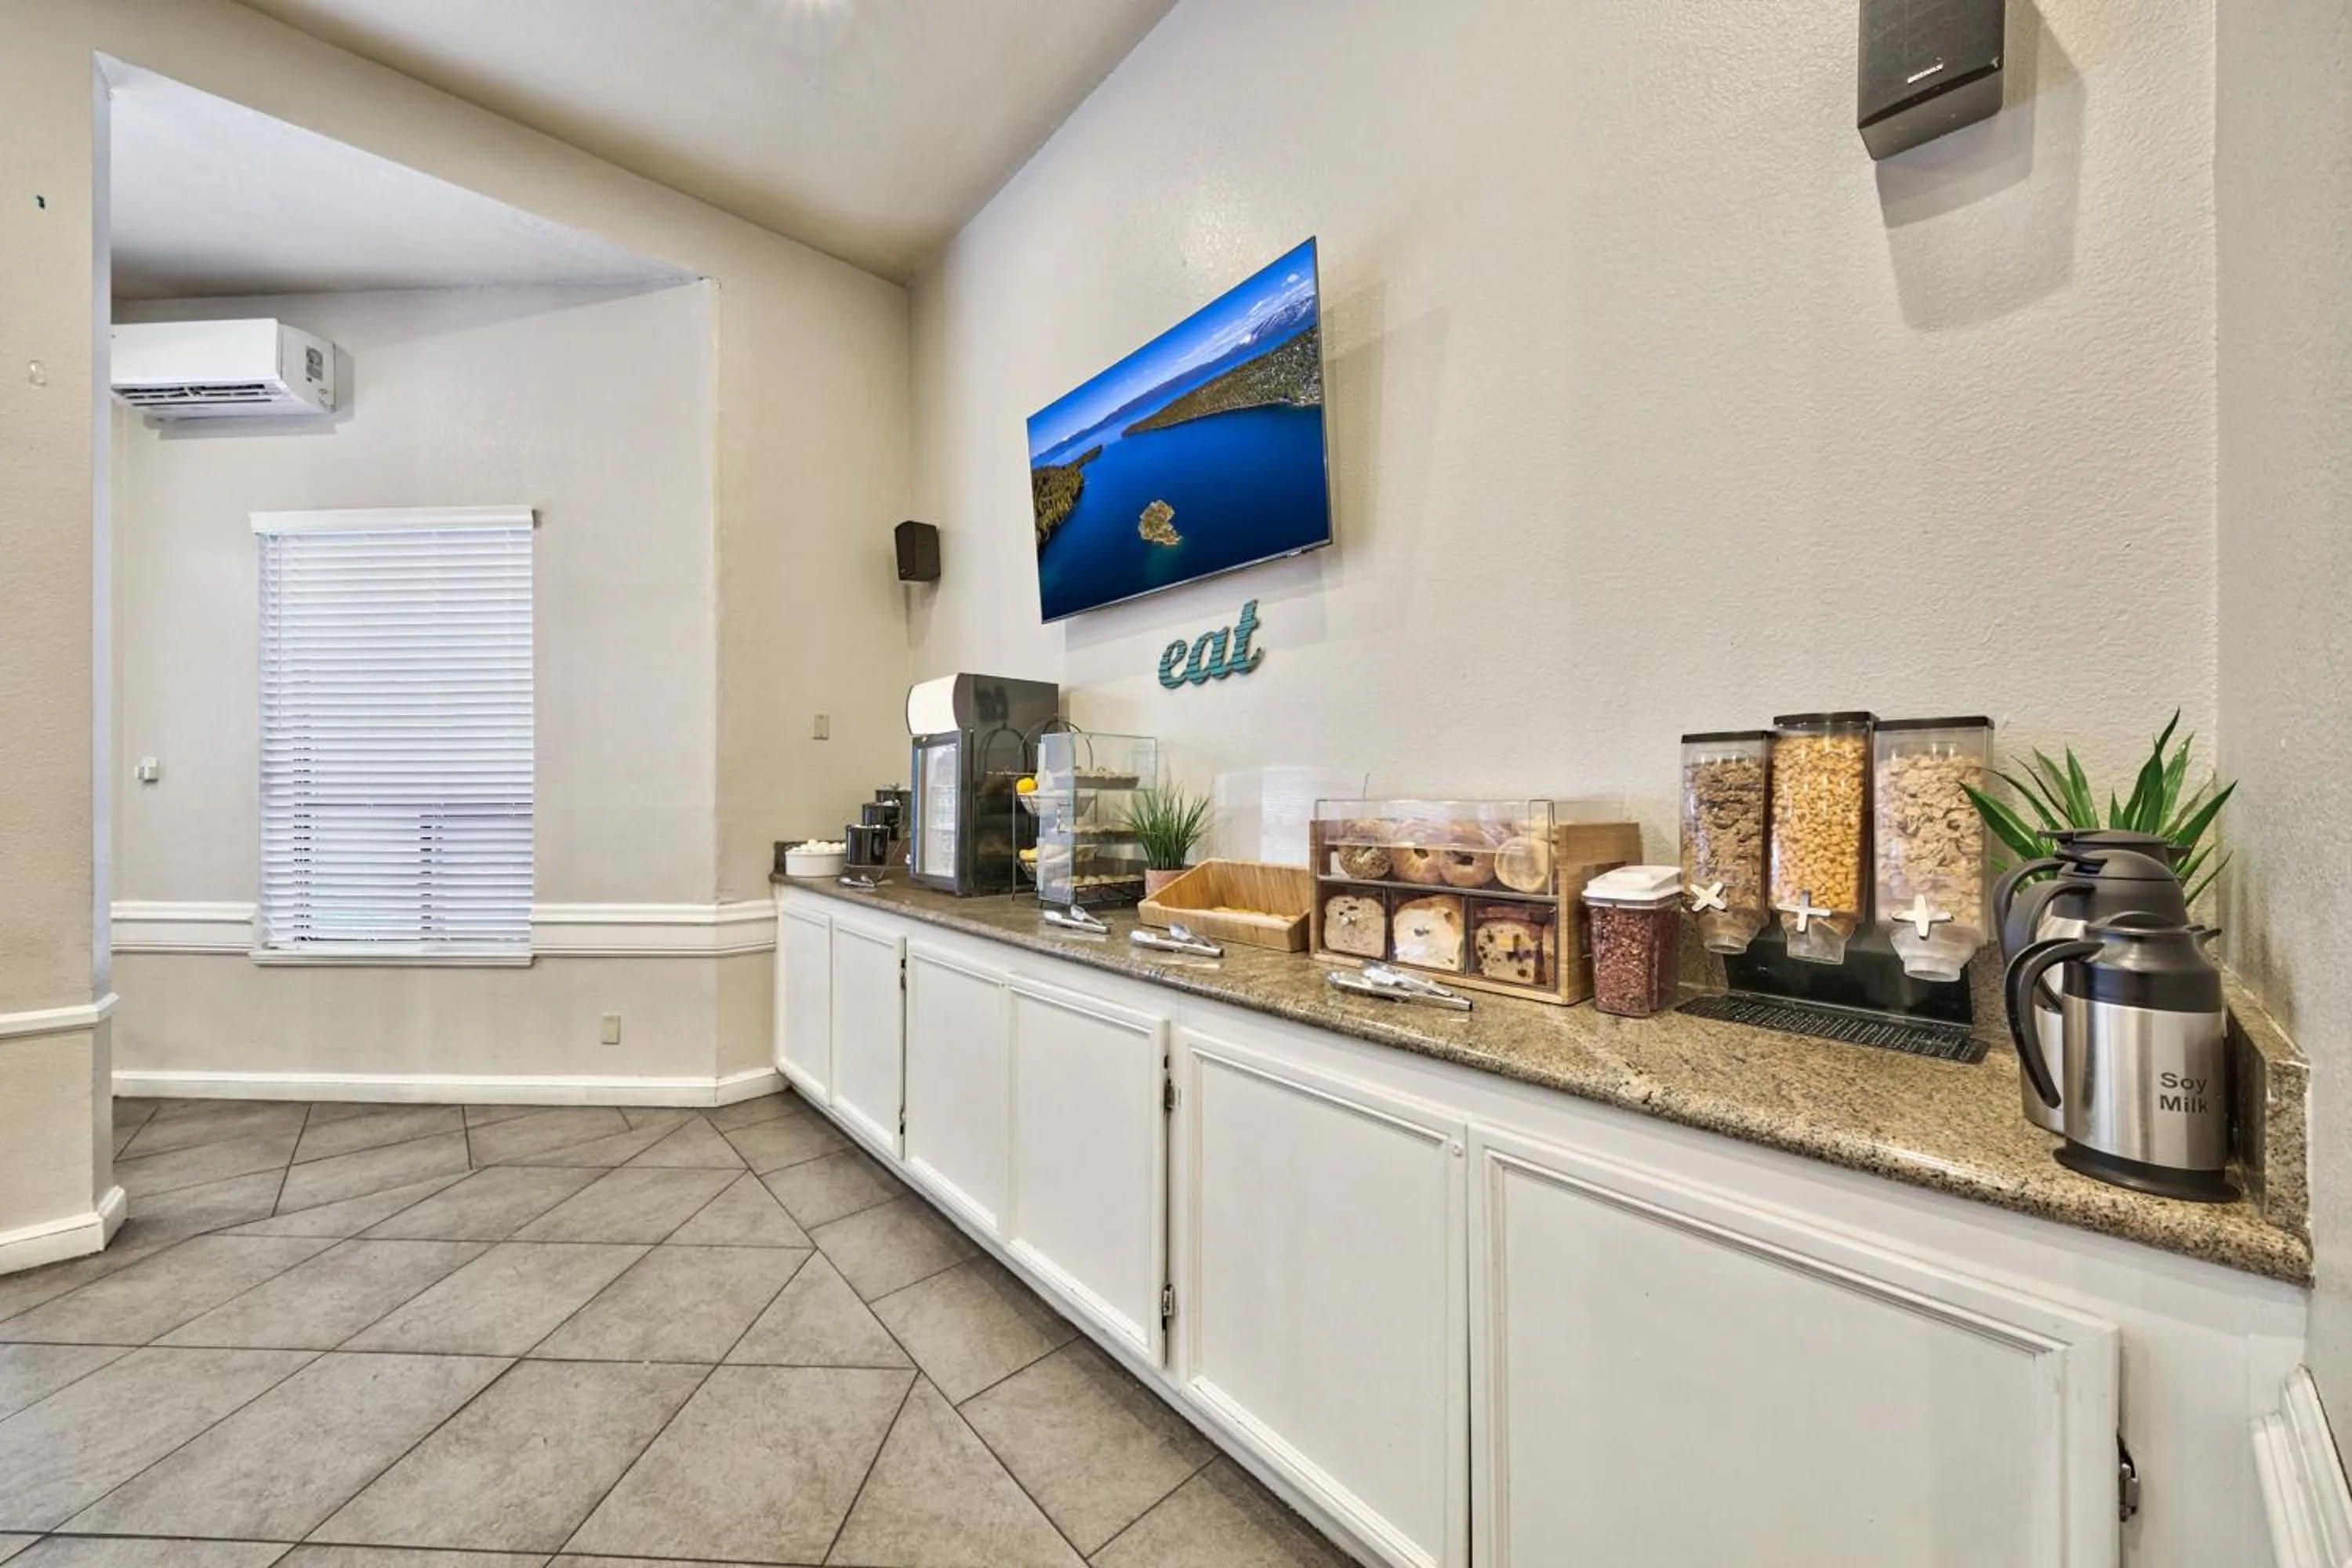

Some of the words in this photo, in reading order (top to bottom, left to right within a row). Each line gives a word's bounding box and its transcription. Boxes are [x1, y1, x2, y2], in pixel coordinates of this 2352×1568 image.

[1159, 600, 1265, 688] eat
[2161, 1072, 2207, 1094] Soy
[2160, 1094, 2208, 1113] Milk
